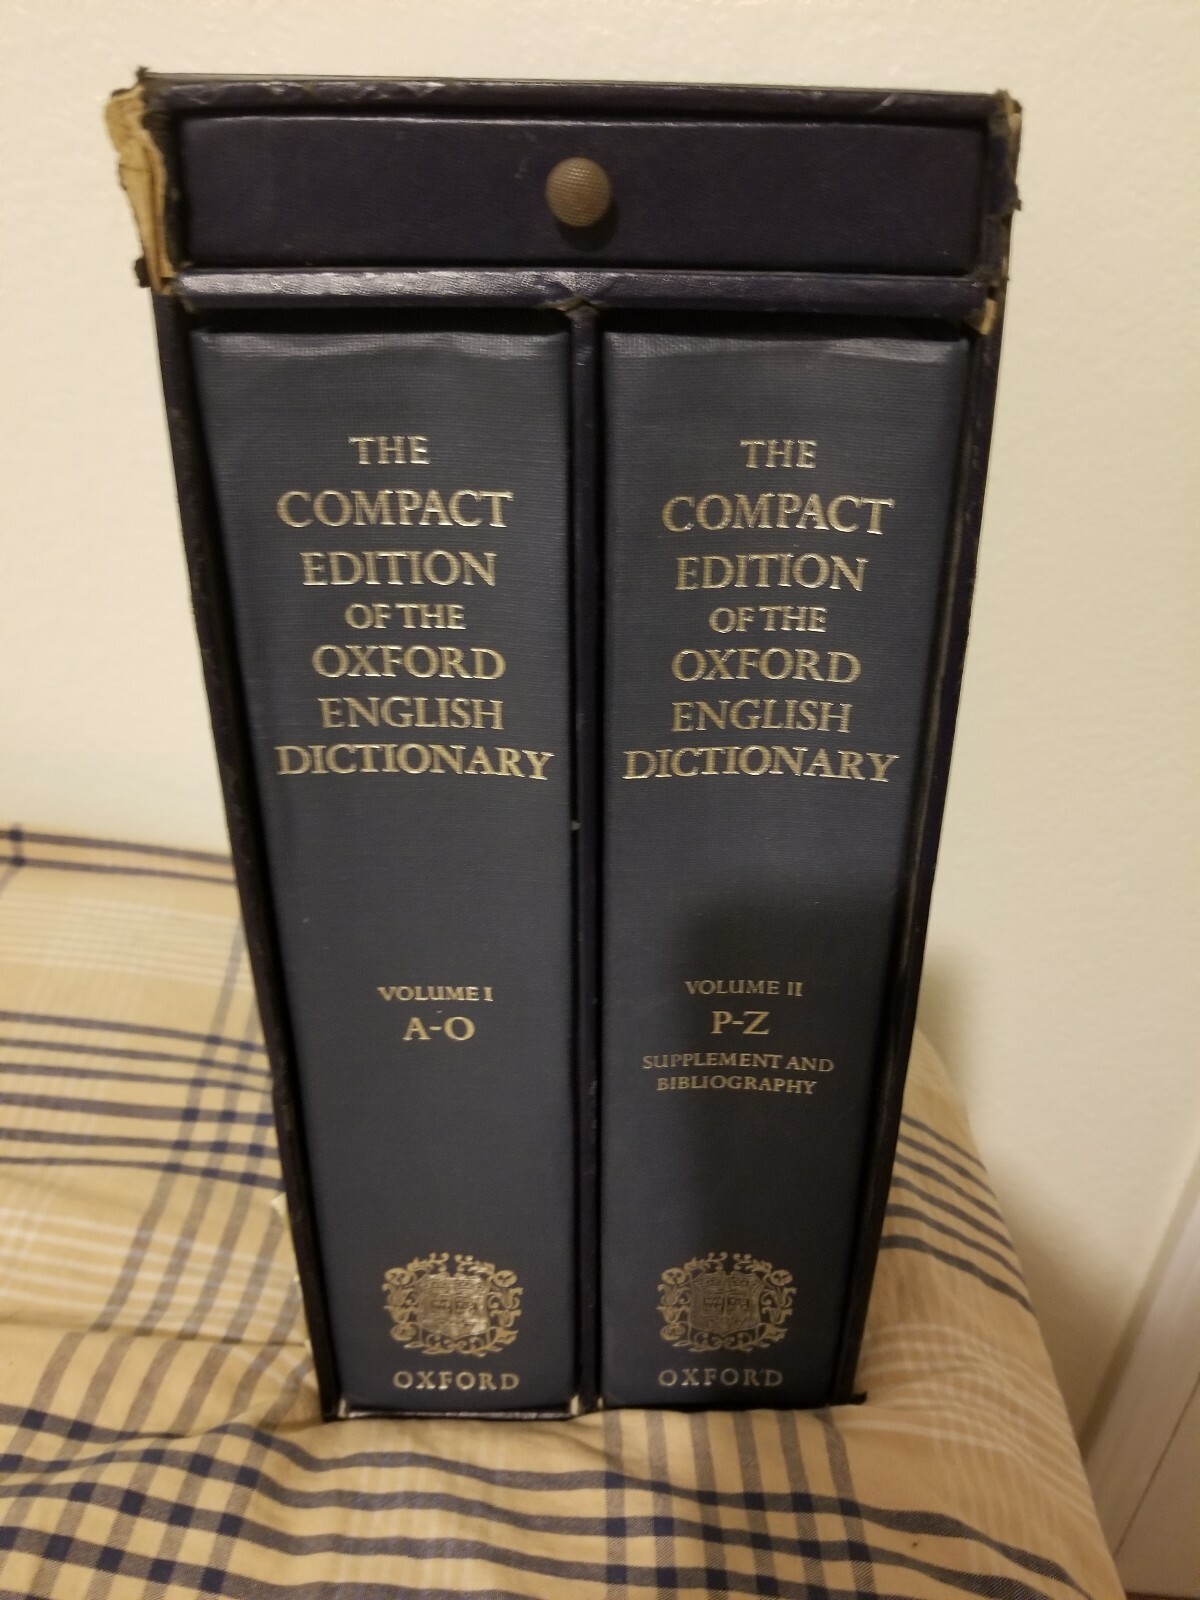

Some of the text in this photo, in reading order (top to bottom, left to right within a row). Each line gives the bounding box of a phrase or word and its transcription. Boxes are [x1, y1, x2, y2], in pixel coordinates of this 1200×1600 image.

[349, 435, 430, 465] THE
[740, 439, 818, 468] THE
[276, 489, 514, 527] COMPACT
[661, 493, 895, 535] COMPACT
[300, 550, 497, 586] EDITION
[675, 553, 868, 592] EDITION
[345, 603, 466, 630] OF THE
[708, 606, 828, 633] OF THE
[312, 645, 506, 680] OXFORD
[671, 648, 862, 683] OXFORD
[317, 696, 504, 730] ENGLISH
[671, 699, 853, 733] ENGLISH
[274, 743, 554, 780] DICTIONARY
[622, 745, 899, 782] DICTIONARY
[377, 985, 493, 1002] VOLUME I
[685, 979, 804, 997] VOLUME II
[403, 1016, 477, 1041] A-O
[711, 1010, 771, 1035] P-Z
[642, 1052, 834, 1073] SUPPLEMENT AND
[656, 1075, 817, 1094] BIBLIOGRAPHY
[392, 1371, 520, 1390] OXFORD
[659, 1368, 784, 1387] OXFORD
